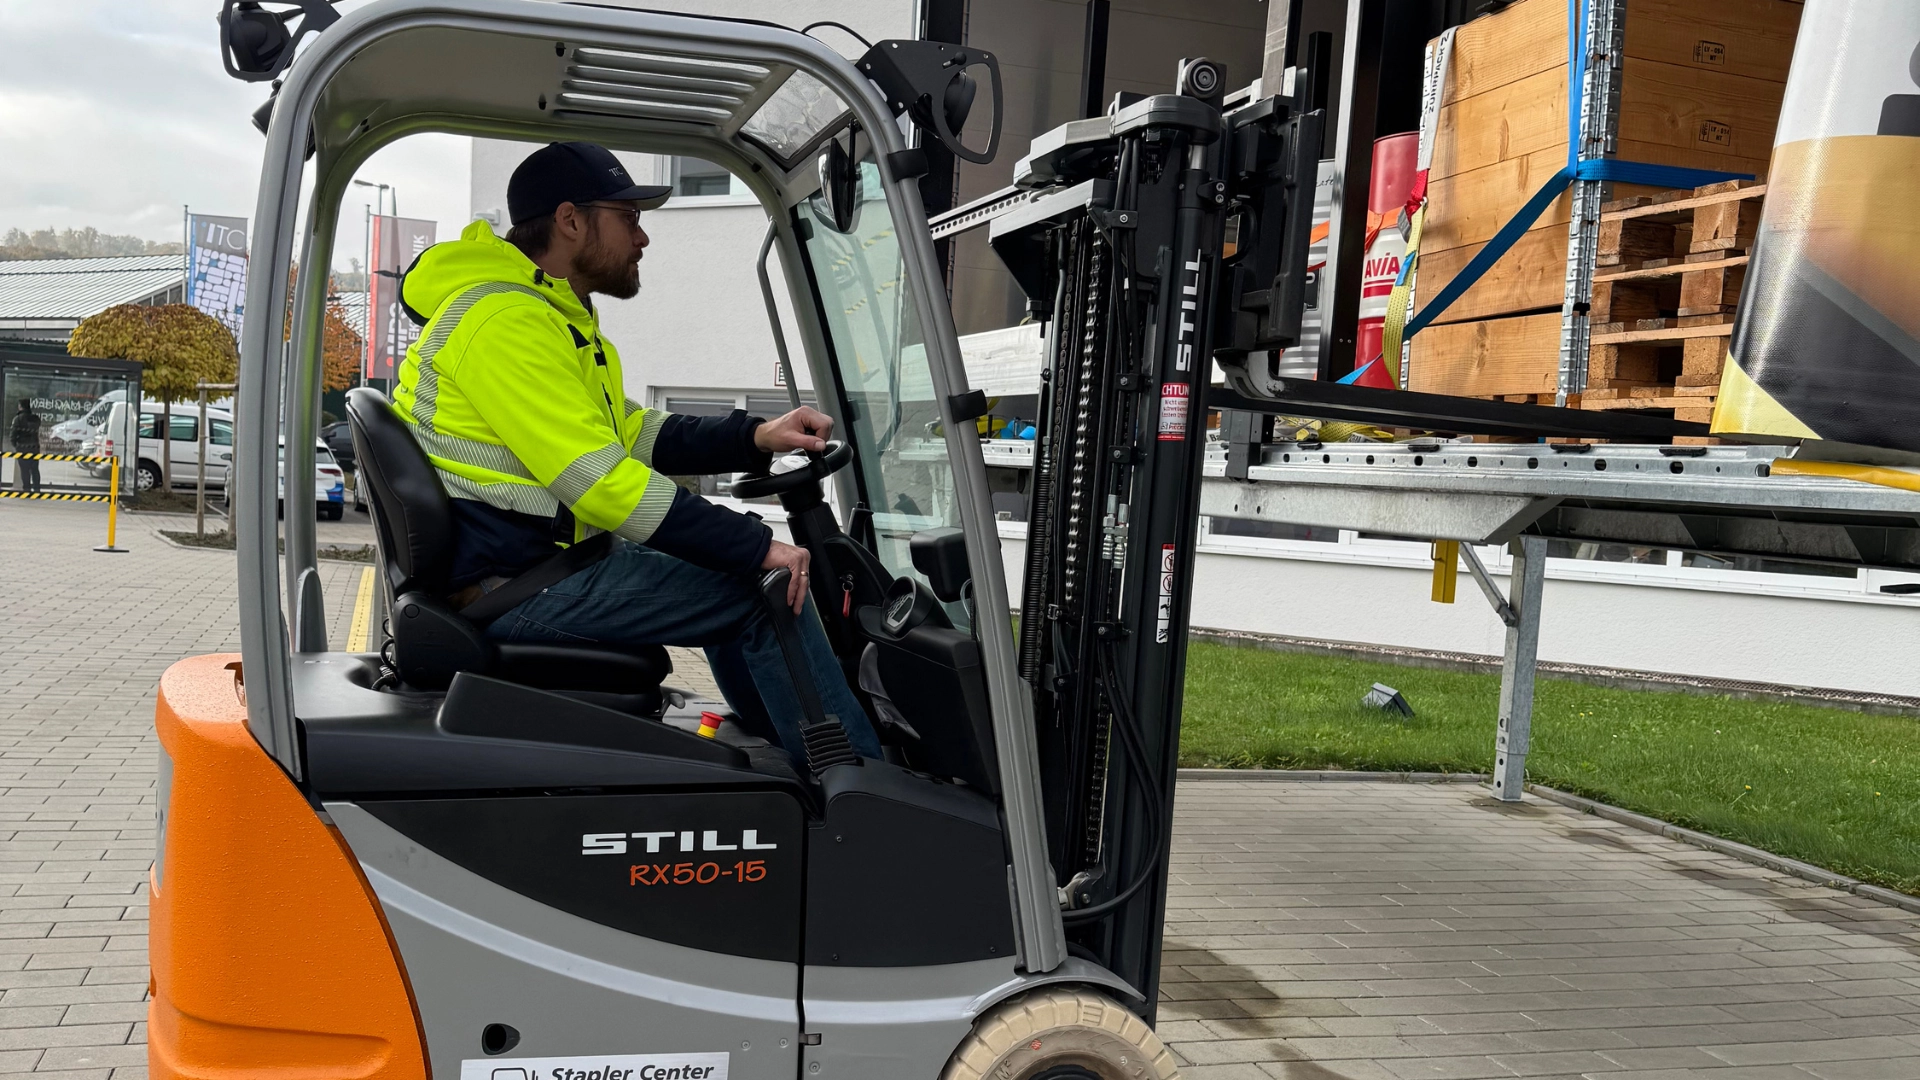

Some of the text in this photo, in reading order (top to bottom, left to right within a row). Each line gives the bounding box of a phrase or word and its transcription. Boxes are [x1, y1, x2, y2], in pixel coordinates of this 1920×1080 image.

[206, 222, 245, 250] ITC
[1175, 248, 1201, 372] STILL
[581, 829, 778, 856] STILL
[630, 860, 767, 886] RX50-15
[551, 1064, 715, 1080] Stapler Center
